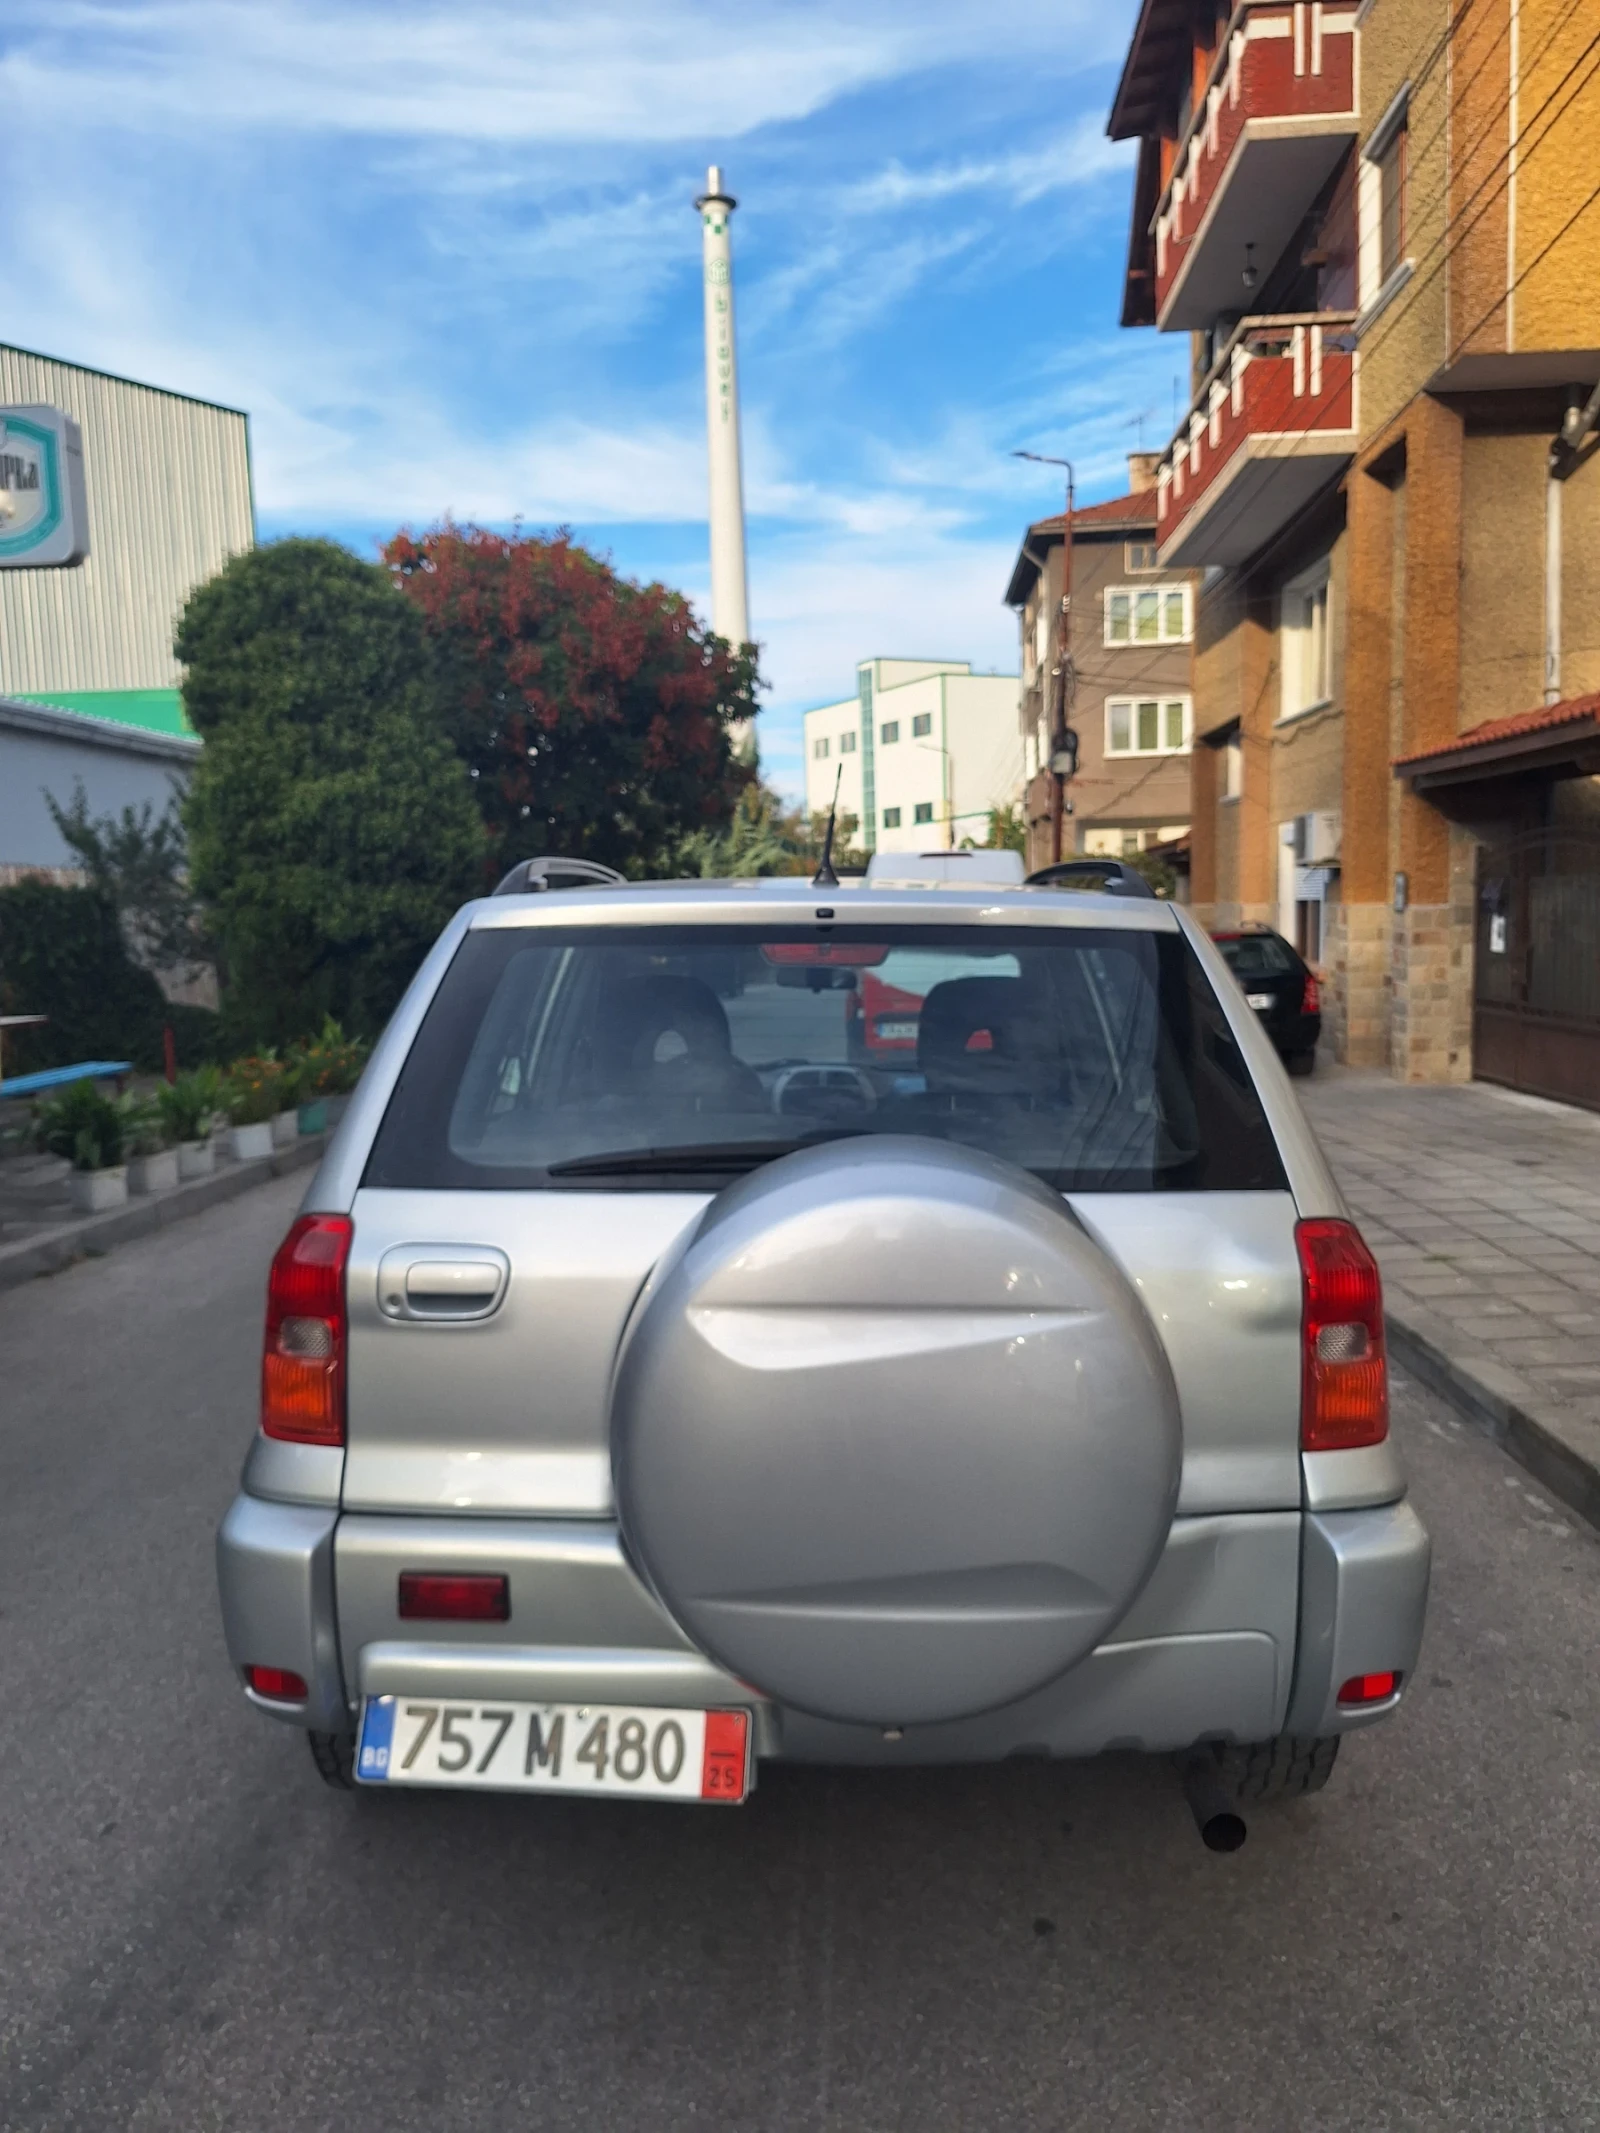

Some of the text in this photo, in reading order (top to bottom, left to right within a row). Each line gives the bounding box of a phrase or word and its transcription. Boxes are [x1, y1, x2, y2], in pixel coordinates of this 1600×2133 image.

[400, 1705, 685, 1783] 757 M 480
[362, 1746, 388, 1768] BG
[709, 1765, 736, 1789] 25
